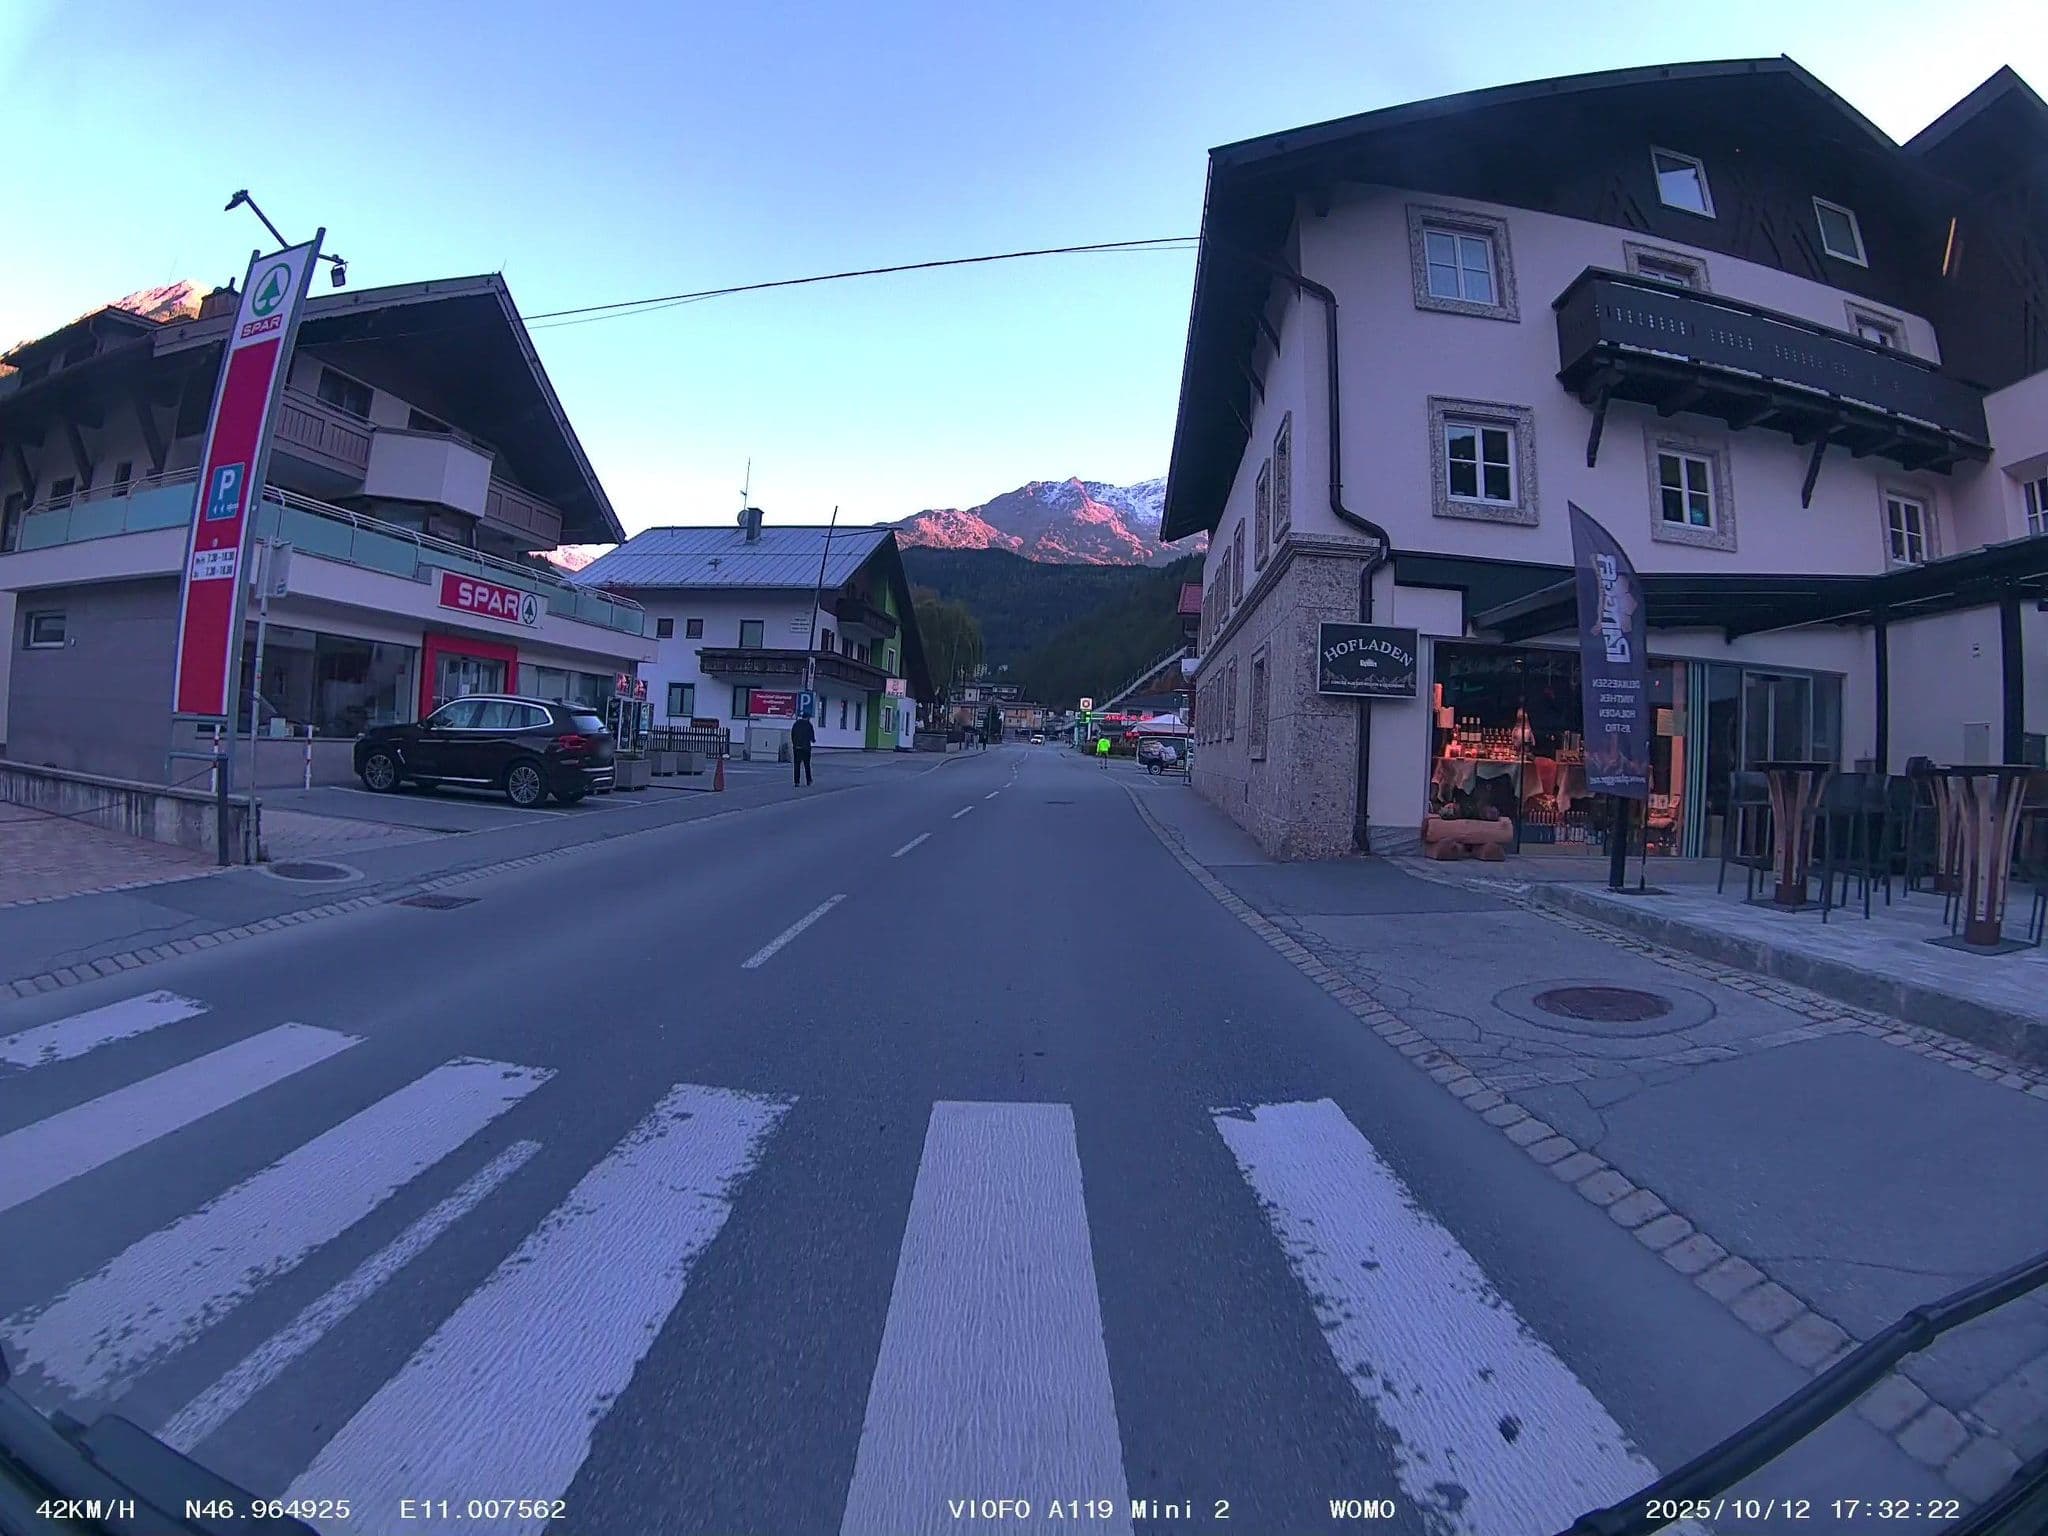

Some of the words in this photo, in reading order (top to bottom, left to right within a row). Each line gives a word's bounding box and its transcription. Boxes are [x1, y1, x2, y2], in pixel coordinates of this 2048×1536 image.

[242, 316, 281, 337] SPAR
[217, 469, 236, 500] P
[458, 582, 519, 617] SPAR
[1323, 638, 1414, 667] HOFLADEN
[800, 693, 811, 712] P
